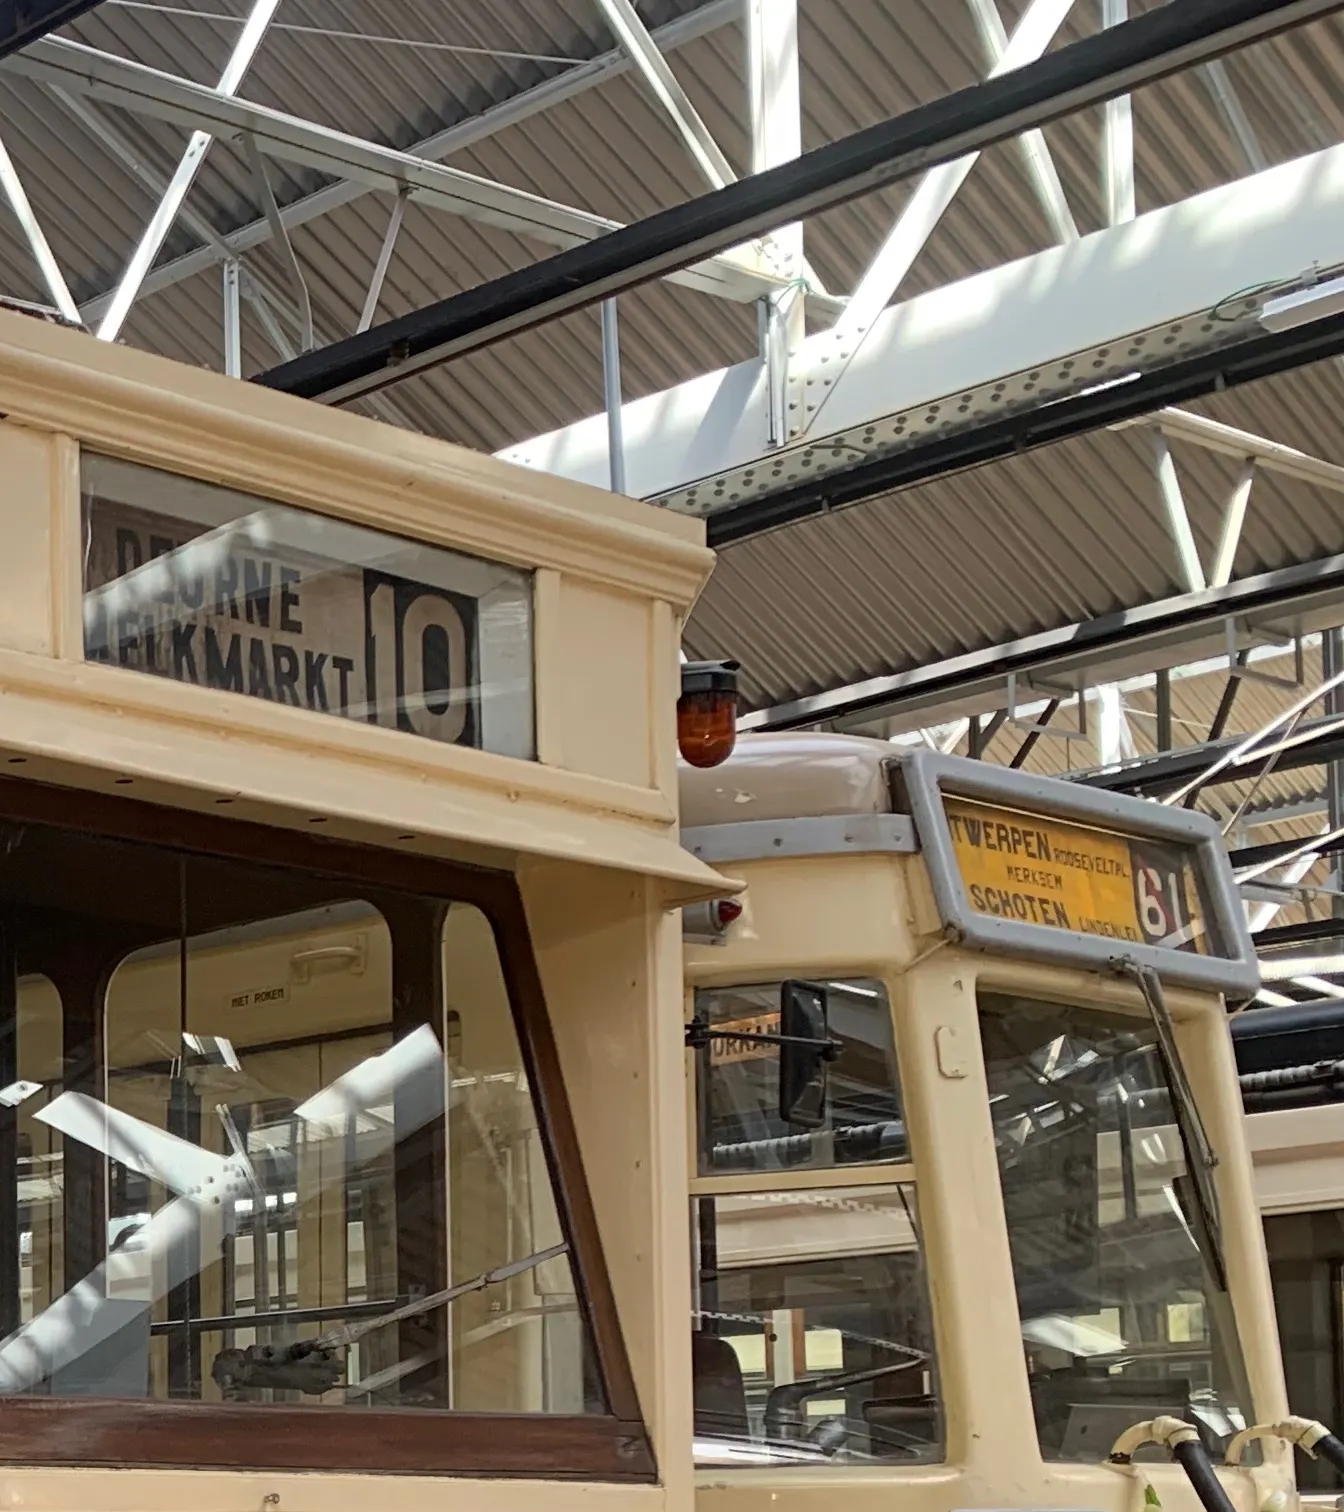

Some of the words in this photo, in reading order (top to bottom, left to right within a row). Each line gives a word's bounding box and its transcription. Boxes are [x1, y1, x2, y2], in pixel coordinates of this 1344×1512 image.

[370, 583, 468, 744] 10
[969, 884, 1071, 930] SCHOTEN
[1006, 864, 1063, 890] MERKSEM
[1136, 866, 1185, 940] 61
